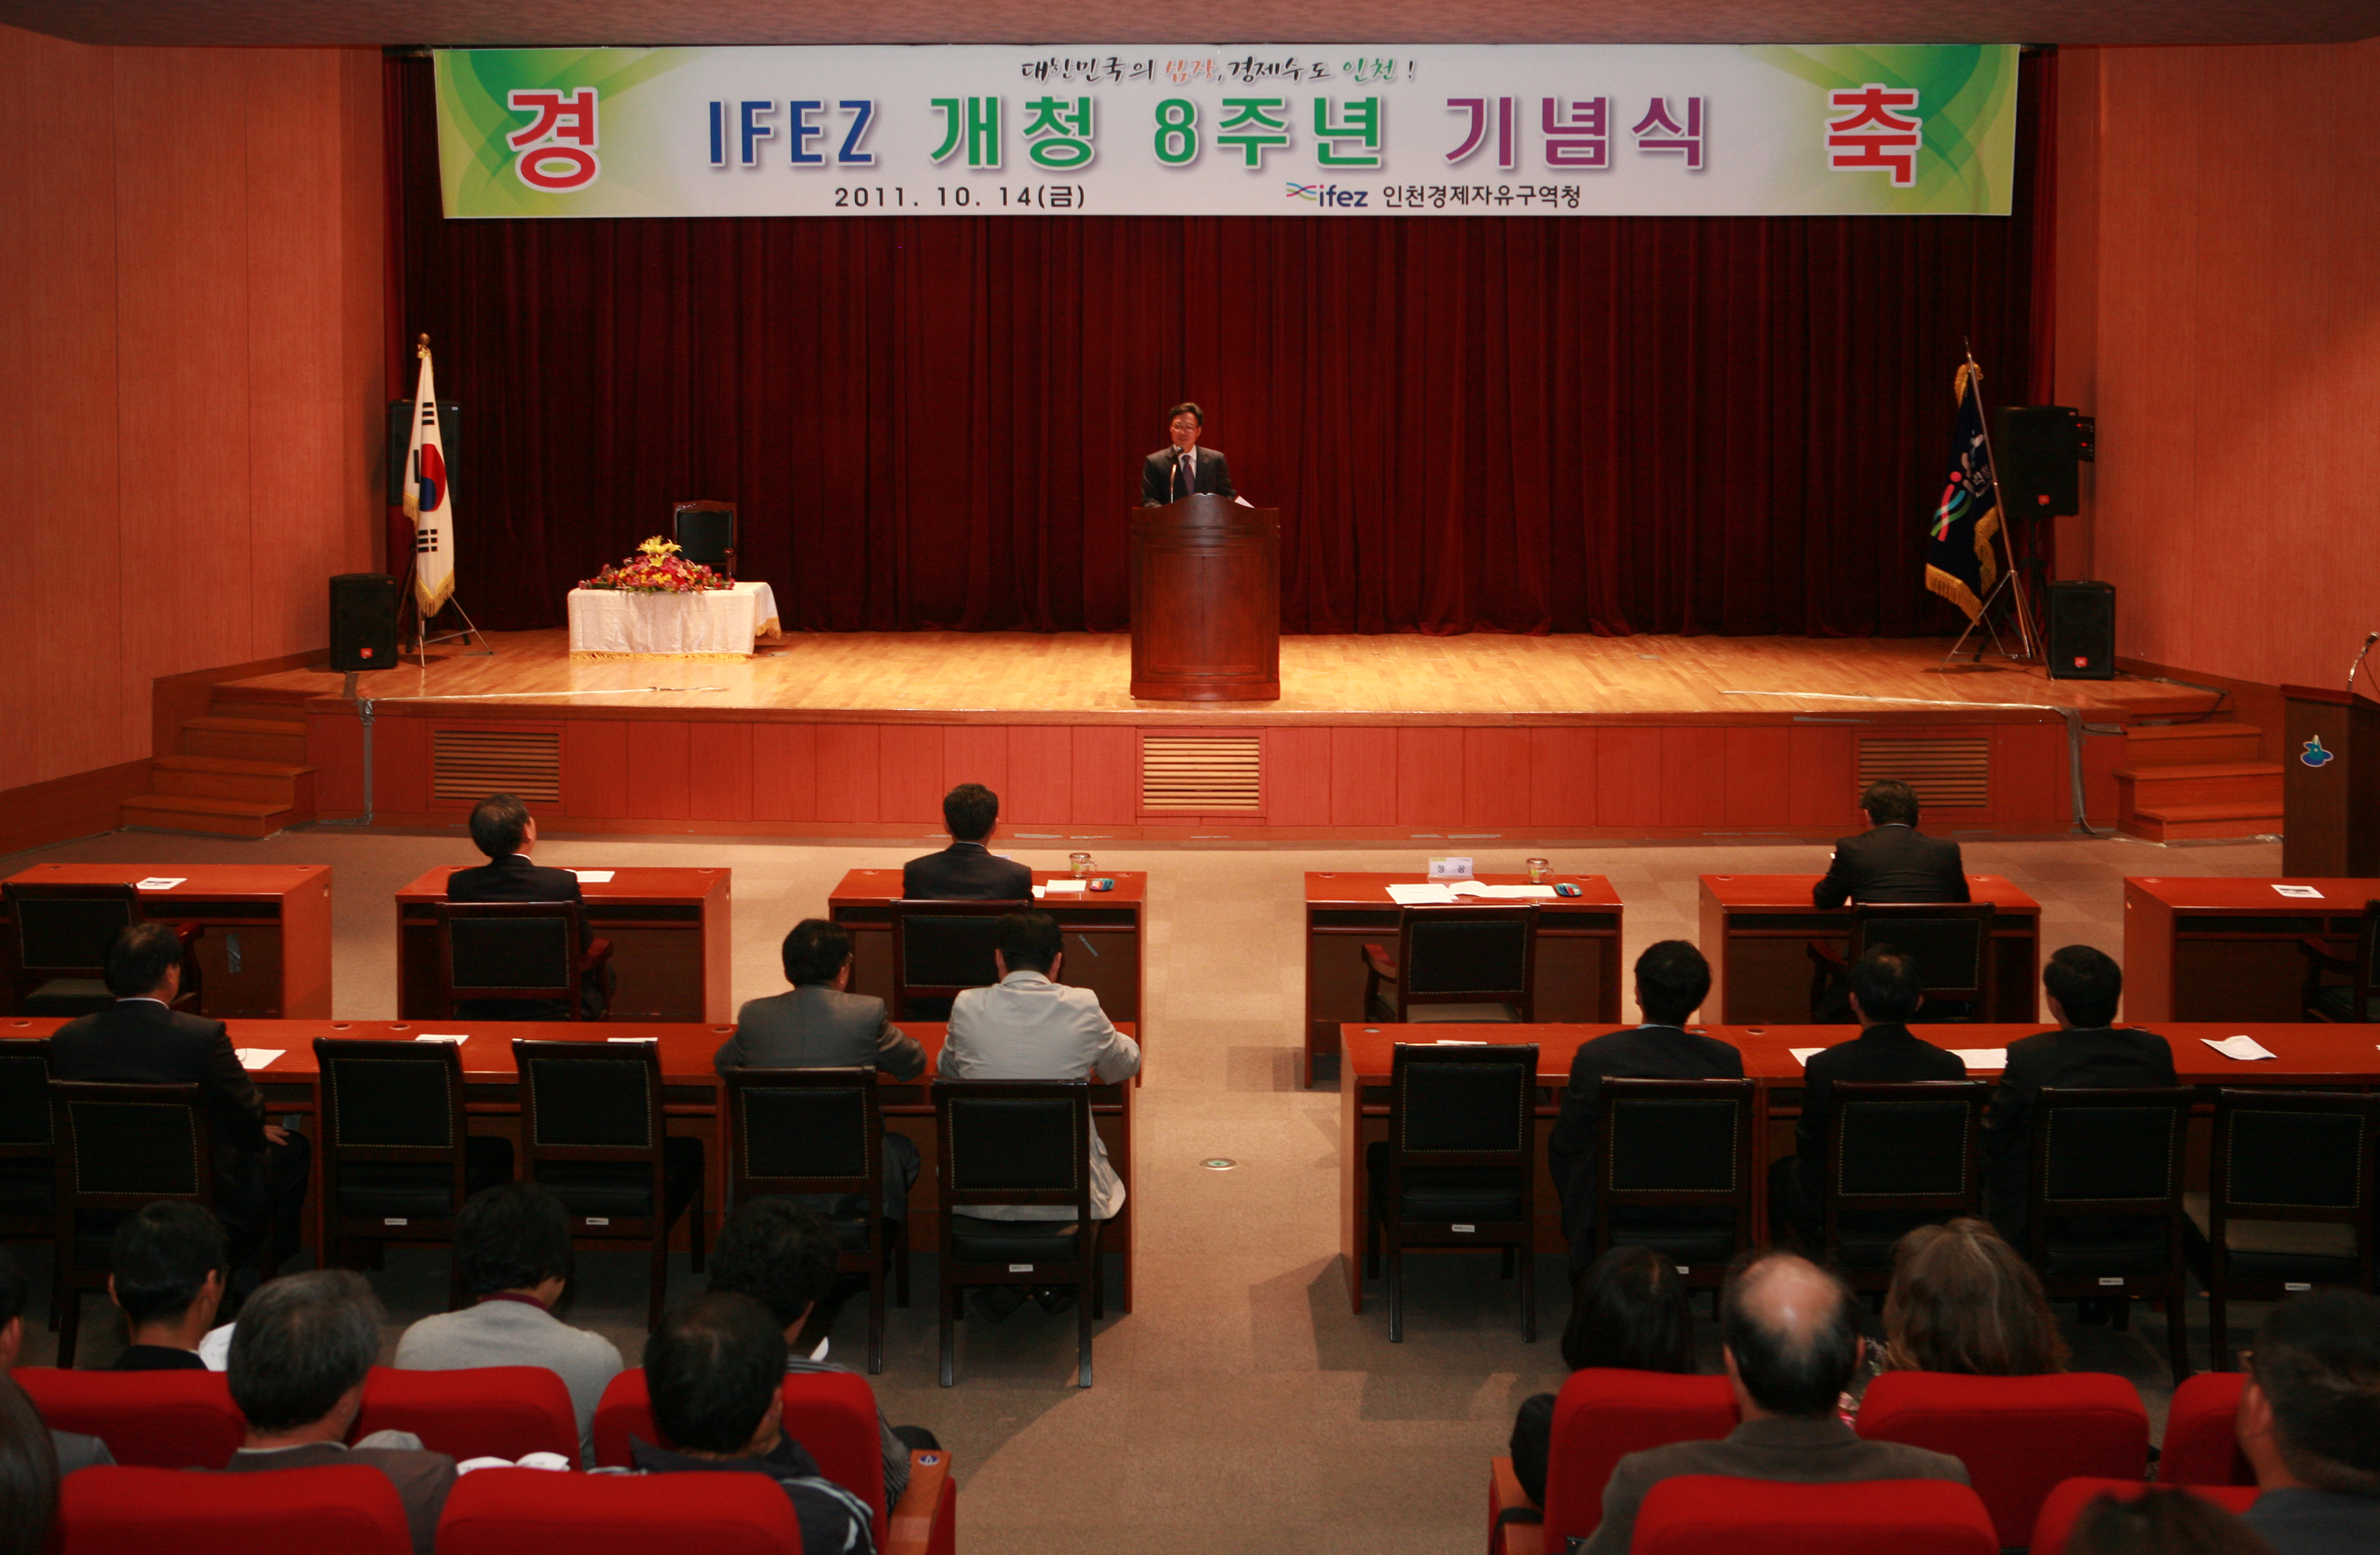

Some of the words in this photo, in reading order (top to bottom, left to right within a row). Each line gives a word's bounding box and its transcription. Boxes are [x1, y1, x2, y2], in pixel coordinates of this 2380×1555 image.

[1021, 57, 1153, 82] 대한민국의
[511, 92, 596, 189] 경
[710, 100, 875, 163] IFEZ
[931, 96, 1094, 167] 개청
[1154, 97, 1379, 166] 8주년
[1445, 97, 1702, 167] 기념식
[1829, 88, 1917, 183] 축
[835, 187, 918, 207] 2011.
[937, 186, 980, 207] 10.
[1000, 185, 1084, 209] 14(금)
[1319, 184, 1368, 207] ifez
[1383, 185, 1580, 209] 인천경제자유구역청
